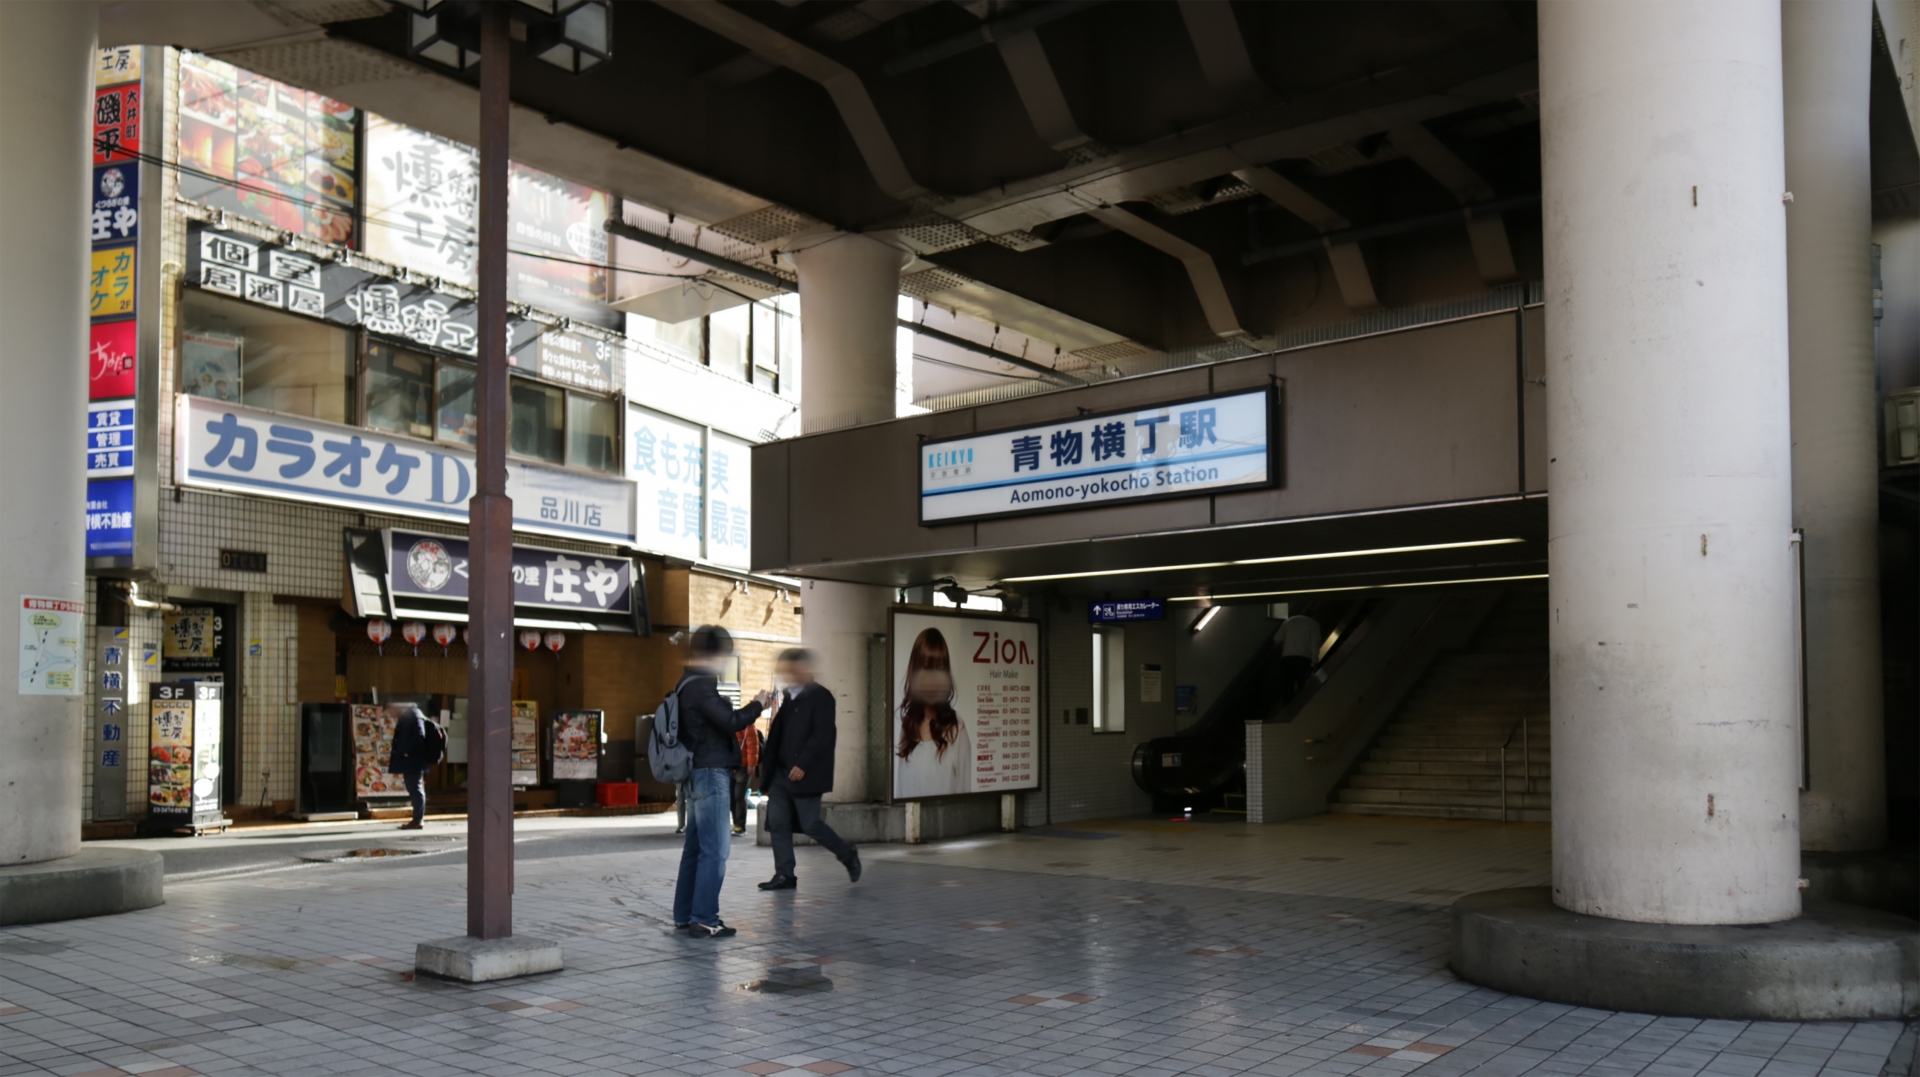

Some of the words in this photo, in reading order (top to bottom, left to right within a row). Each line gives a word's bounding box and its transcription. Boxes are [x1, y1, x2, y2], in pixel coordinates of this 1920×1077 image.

[96, 92, 122, 160] 磯平
[126, 90, 138, 139] 大井町
[402, 211, 477, 271] 工房
[119, 301, 131, 310] 2F
[201, 264, 324, 316] 居酒屋
[595, 340, 611, 361] 3F
[96, 432, 121, 447] 管理
[1011, 407, 1217, 473] 青物横丁駅
[95, 453, 119, 468] 売買
[633, 425, 729, 495] 食も充実
[929, 447, 973, 469] KEIKYU
[1010, 472, 1150, 504] Aomono-yokochō
[1156, 465, 1219, 487] Station
[540, 496, 602, 528] 品川店
[657, 487, 748, 550] 音質最高
[545, 554, 619, 607] 庄や
[177, 636, 203, 653] 工房
[990, 670, 1001, 678] Hair
[1003, 670, 1018, 679] Make
[102, 647, 122, 767] 青横不動産
[159, 686, 184, 699] 3F
[199, 686, 216, 699] 3F
[160, 727, 182, 740] 工房
